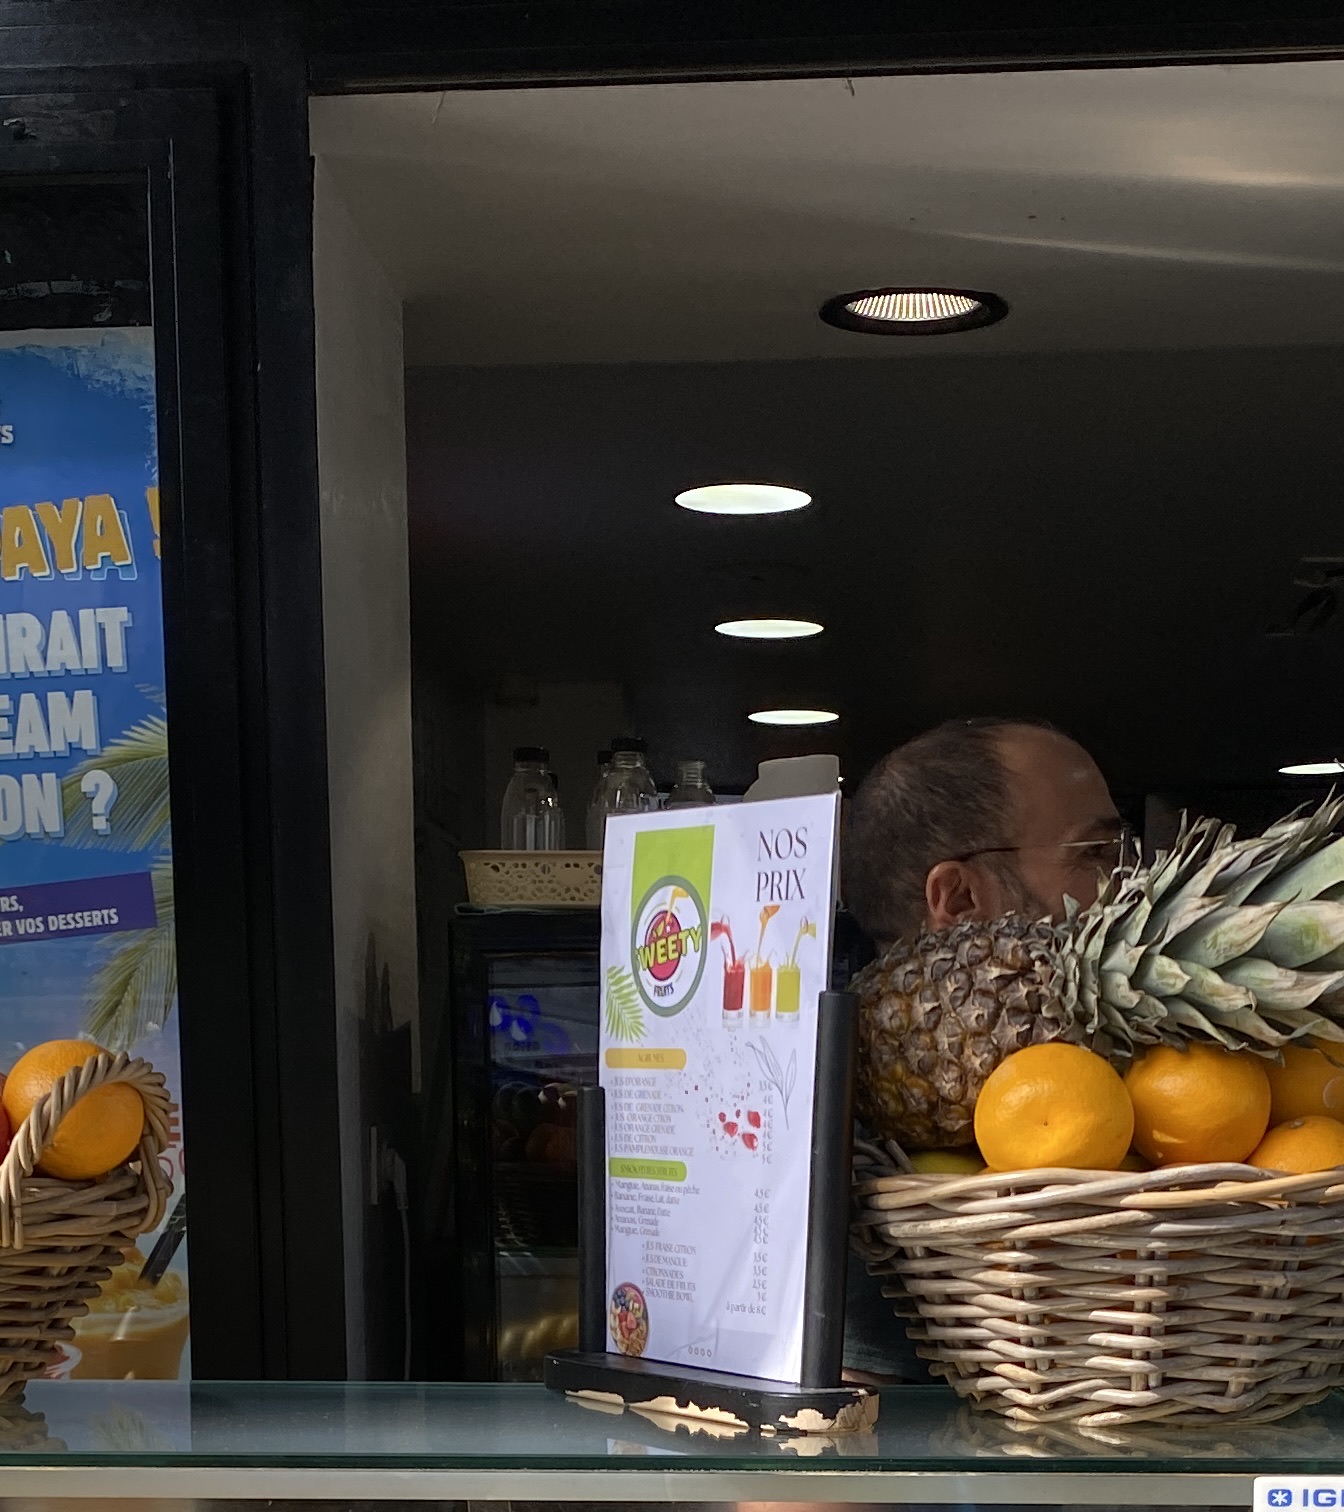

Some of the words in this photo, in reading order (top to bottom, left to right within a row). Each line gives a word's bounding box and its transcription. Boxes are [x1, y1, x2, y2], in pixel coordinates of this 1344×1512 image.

[80, 769, 120, 837] ?
[757, 826, 808, 862] NOS
[756, 867, 807, 902] PRIX
[16, 917, 45, 934] VOS
[47, 908, 119, 932] DESSERTS
[635, 923, 703, 972] WEETY
